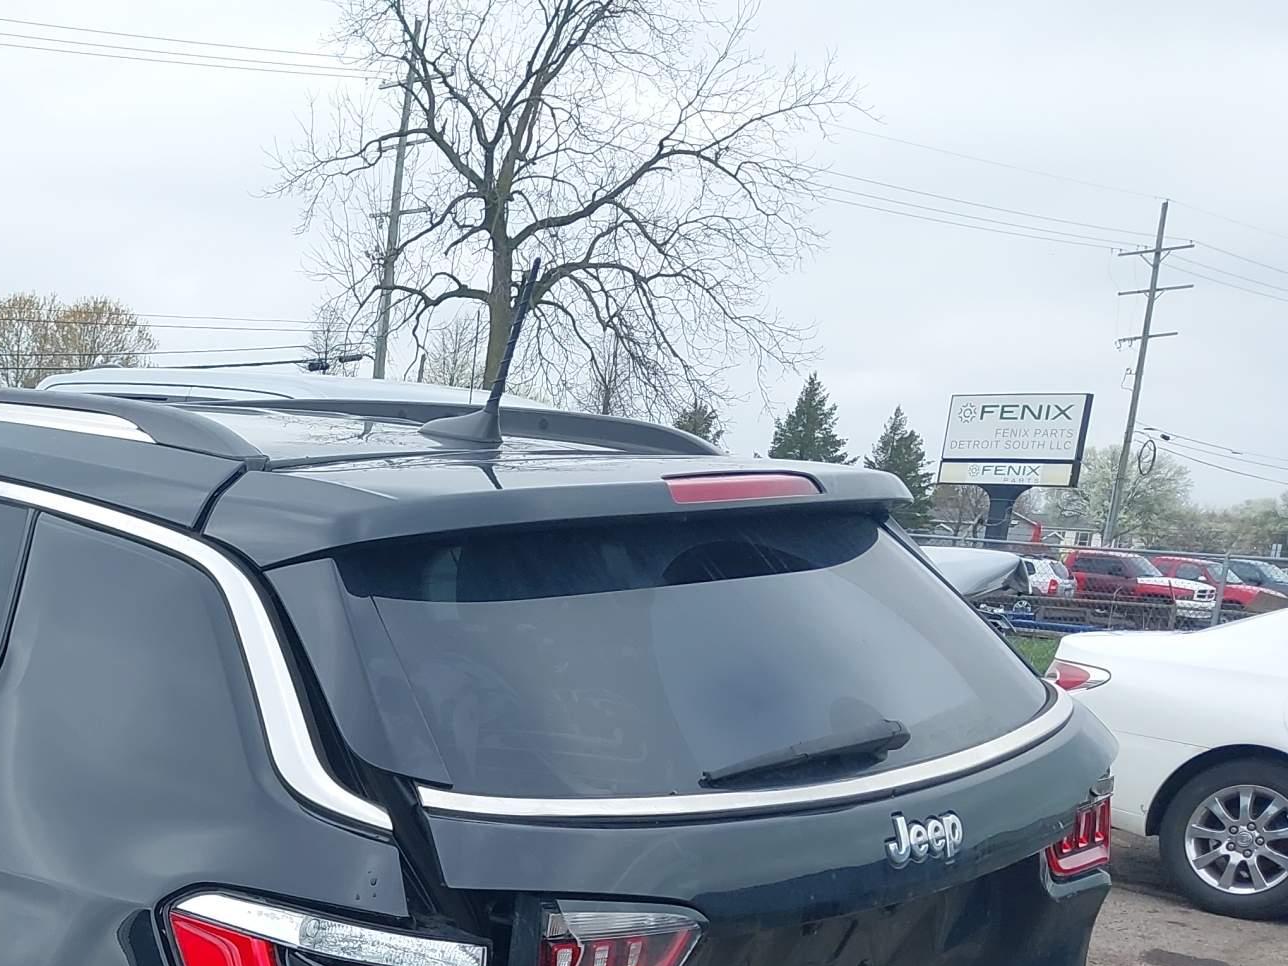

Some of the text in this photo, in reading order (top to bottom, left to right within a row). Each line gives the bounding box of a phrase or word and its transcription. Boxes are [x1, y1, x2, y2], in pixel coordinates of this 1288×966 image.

[979, 404, 1075, 421] FENIX
[994, 428, 1074, 438] FENIX PARTS
[950, 440, 1073, 450] DETROIT SOUTH LLC
[981, 465, 1041, 477] FENIX
[885, 811, 963, 866] Jeep
